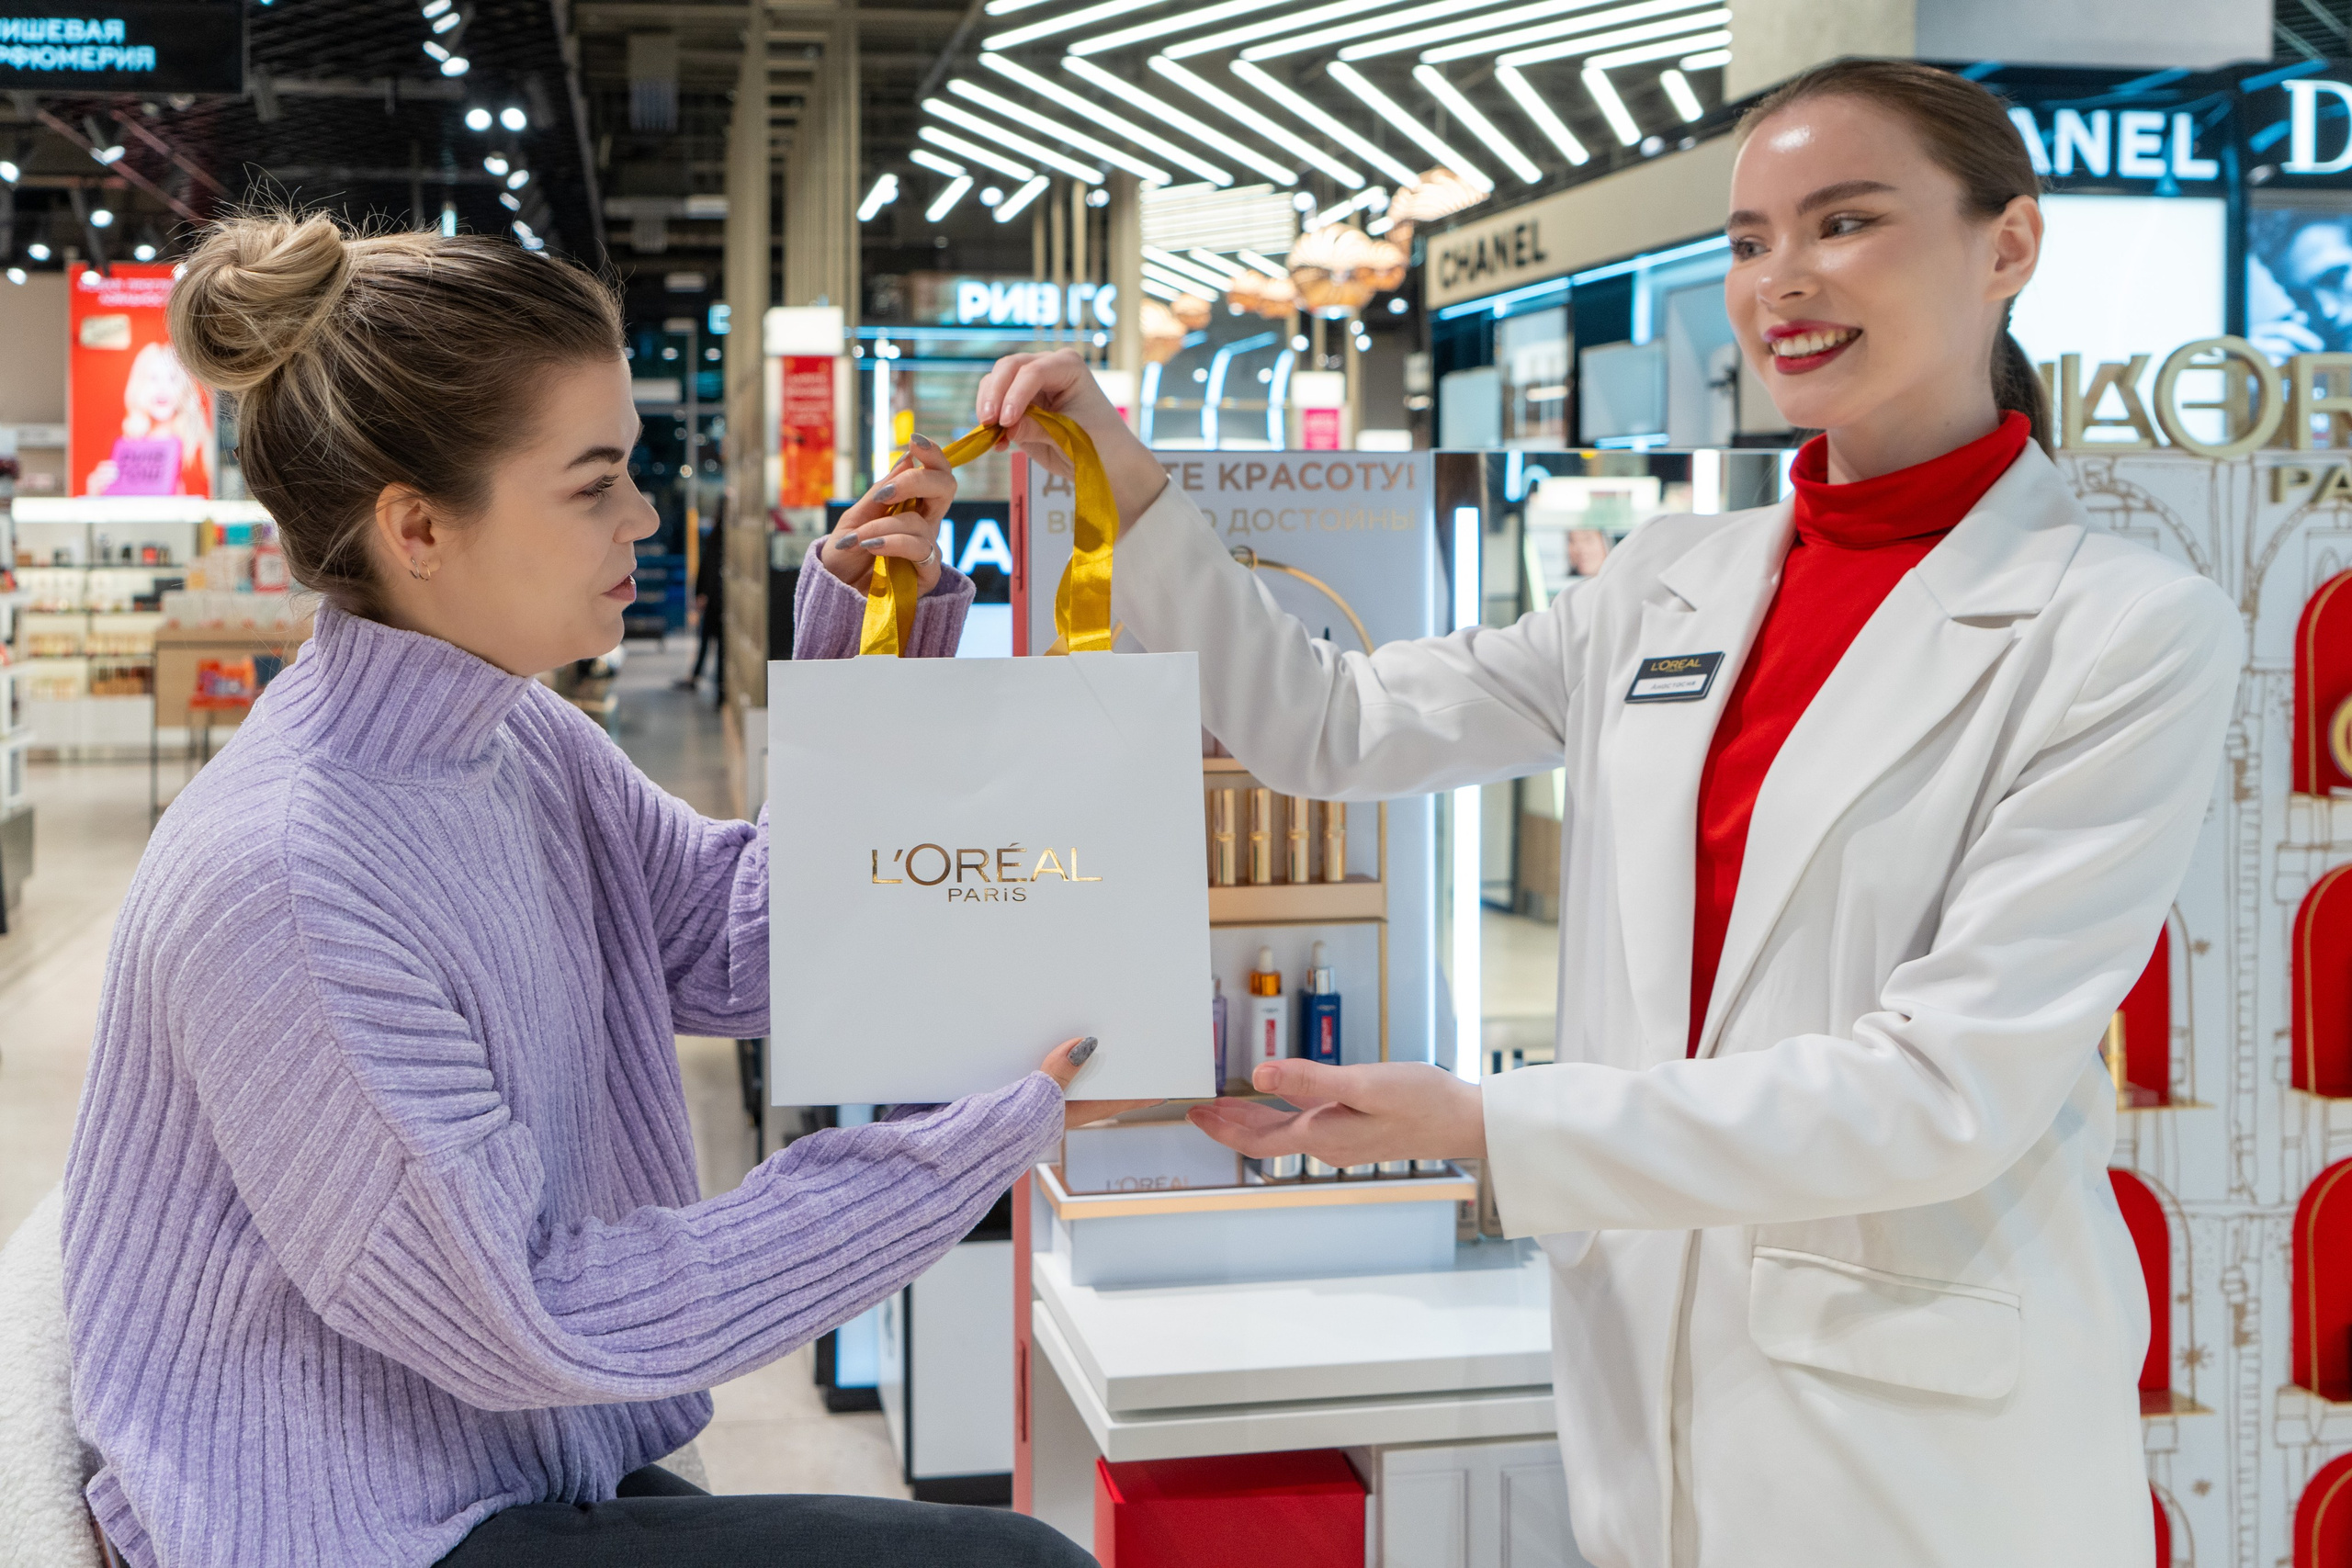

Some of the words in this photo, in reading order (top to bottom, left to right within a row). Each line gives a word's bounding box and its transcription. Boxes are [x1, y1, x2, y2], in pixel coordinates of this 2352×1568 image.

[0, 17, 125, 44] ИШЕВАЯ
[1440, 220, 1547, 288] CHANEL
[957, 281, 1061, 326] РИВ
[1218, 462, 1414, 491] КРАСОТУ!
[1227, 502, 1415, 536] ДОСТОЙНЫ
[872, 842, 1102, 886] L'ORÉAL
